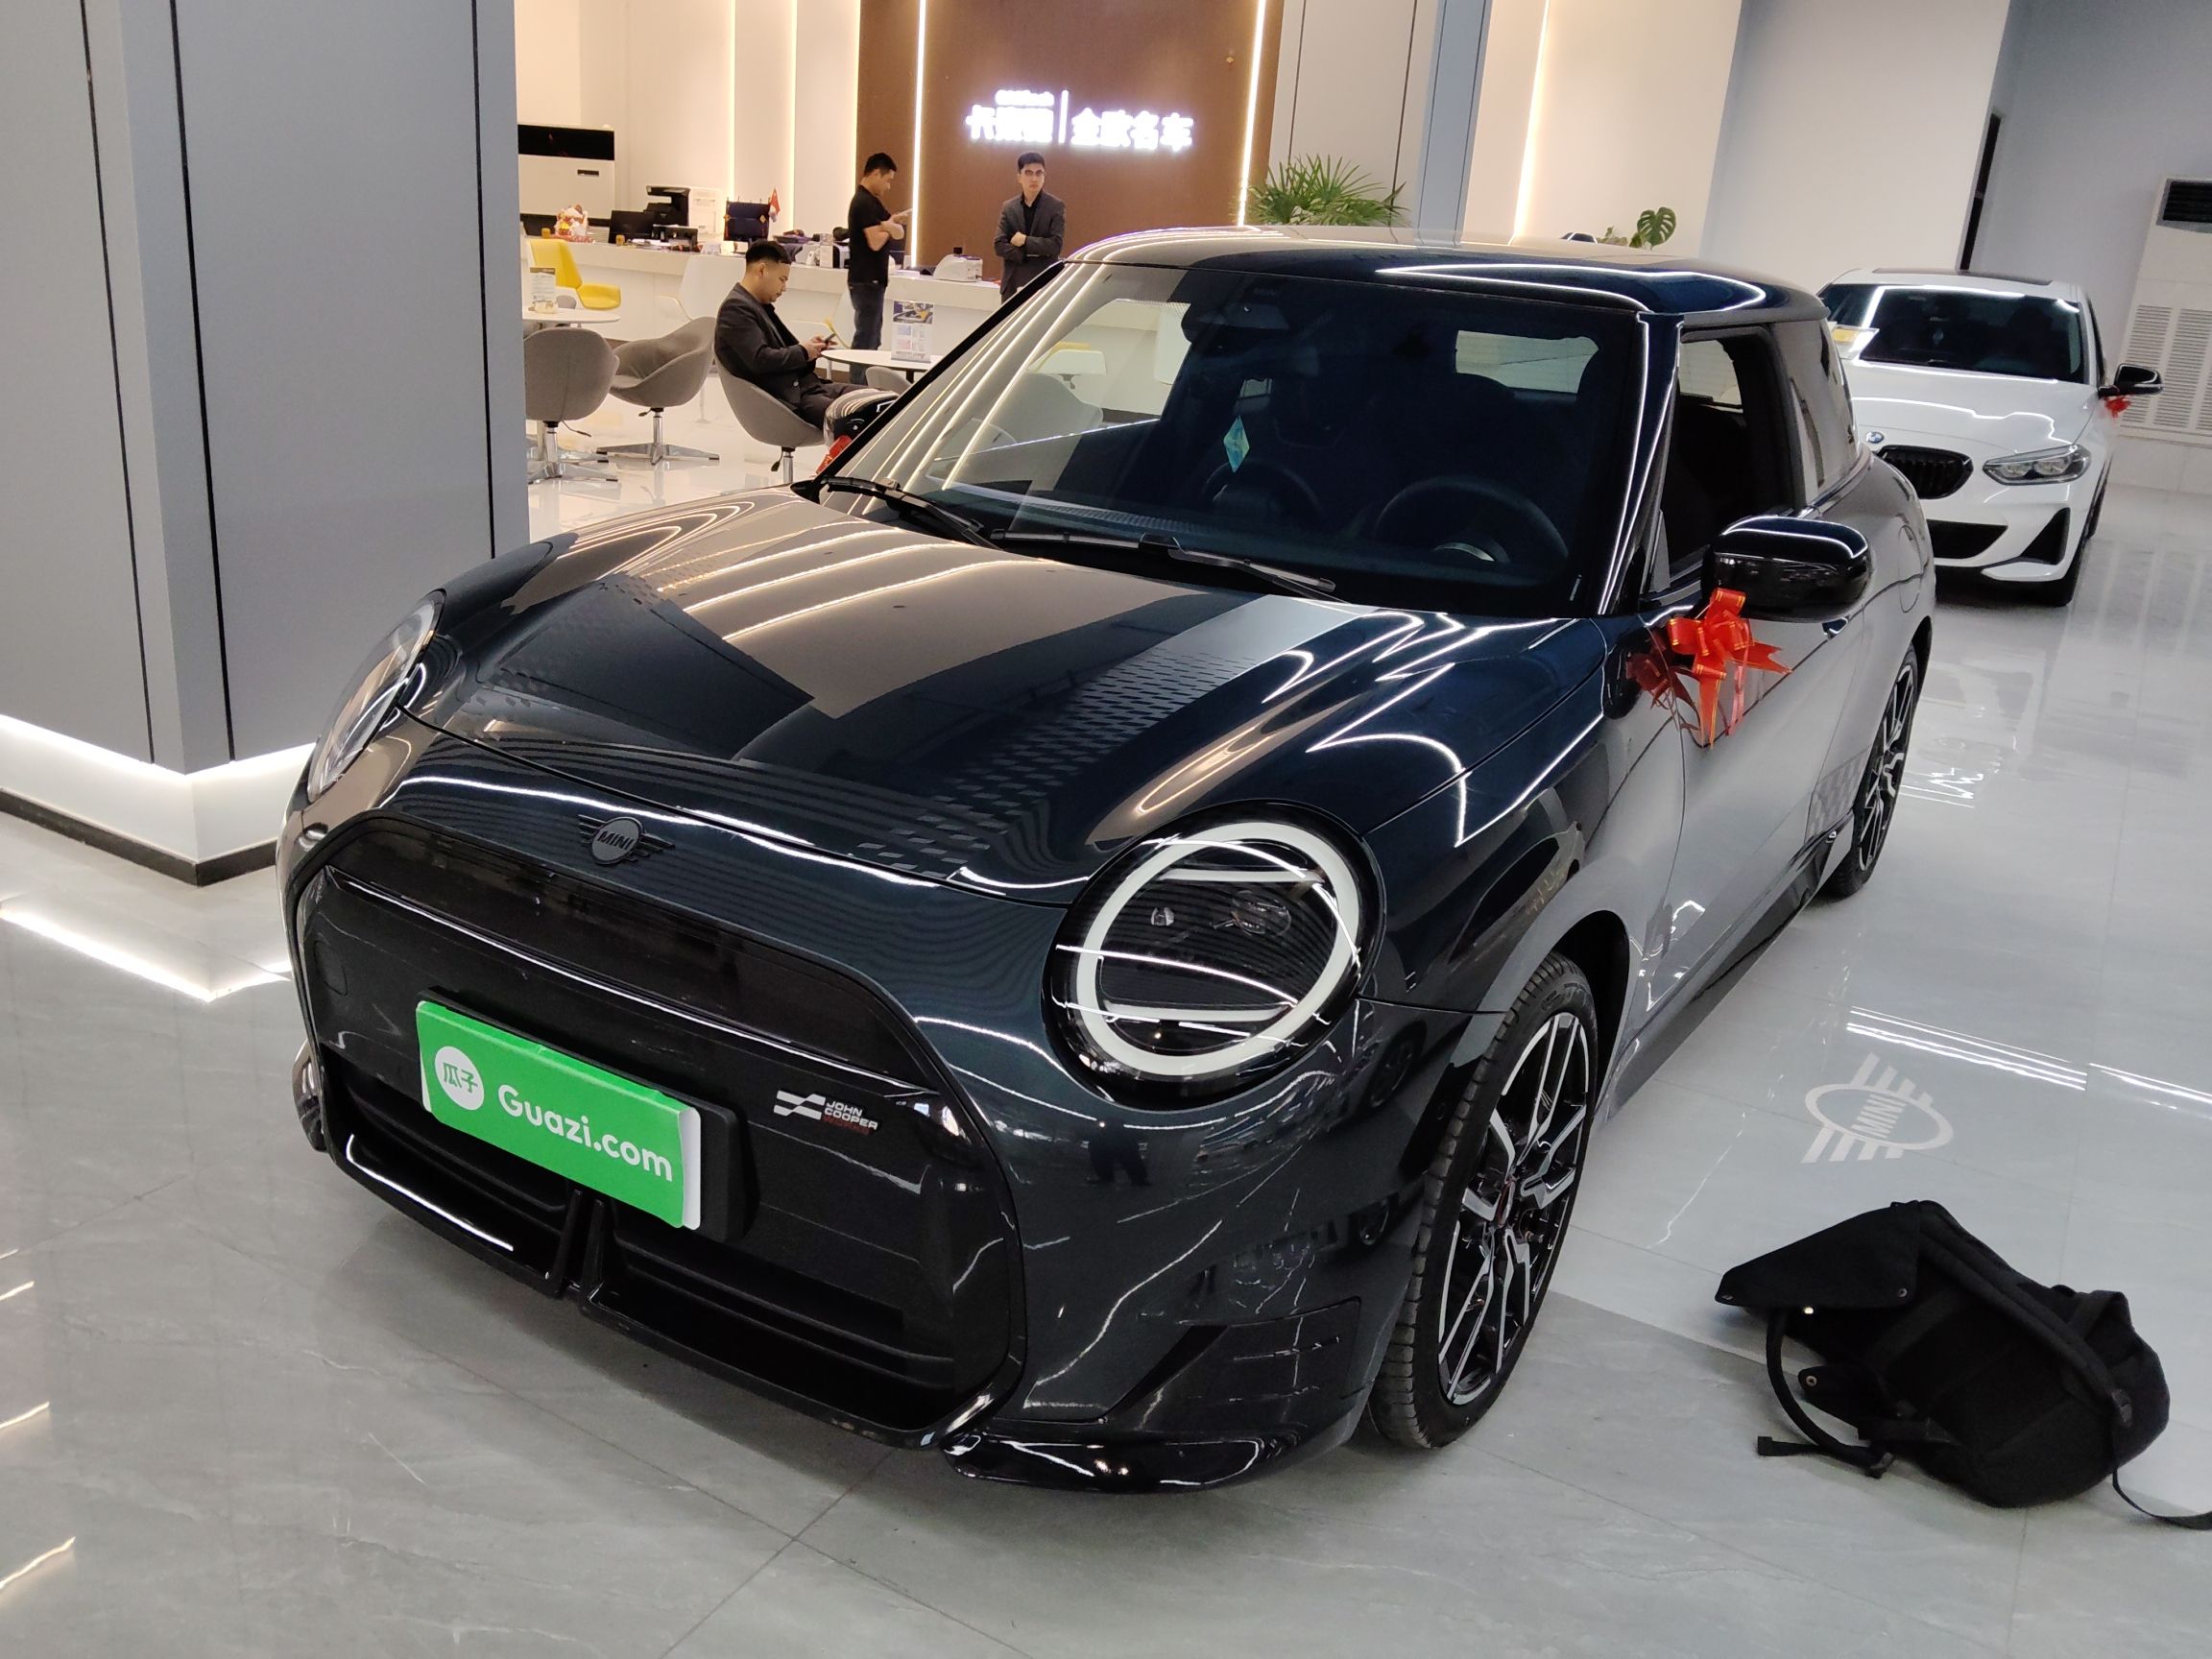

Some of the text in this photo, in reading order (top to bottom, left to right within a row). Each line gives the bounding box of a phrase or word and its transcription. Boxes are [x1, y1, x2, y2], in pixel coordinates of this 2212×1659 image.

[597, 830, 635, 851] MINI
[442, 1062, 477, 1094] 瓜子
[825, 1108, 878, 1130] COOPER
[827, 1101, 862, 1117] JOHN
[498, 1085, 672, 1182] Guazi.com
